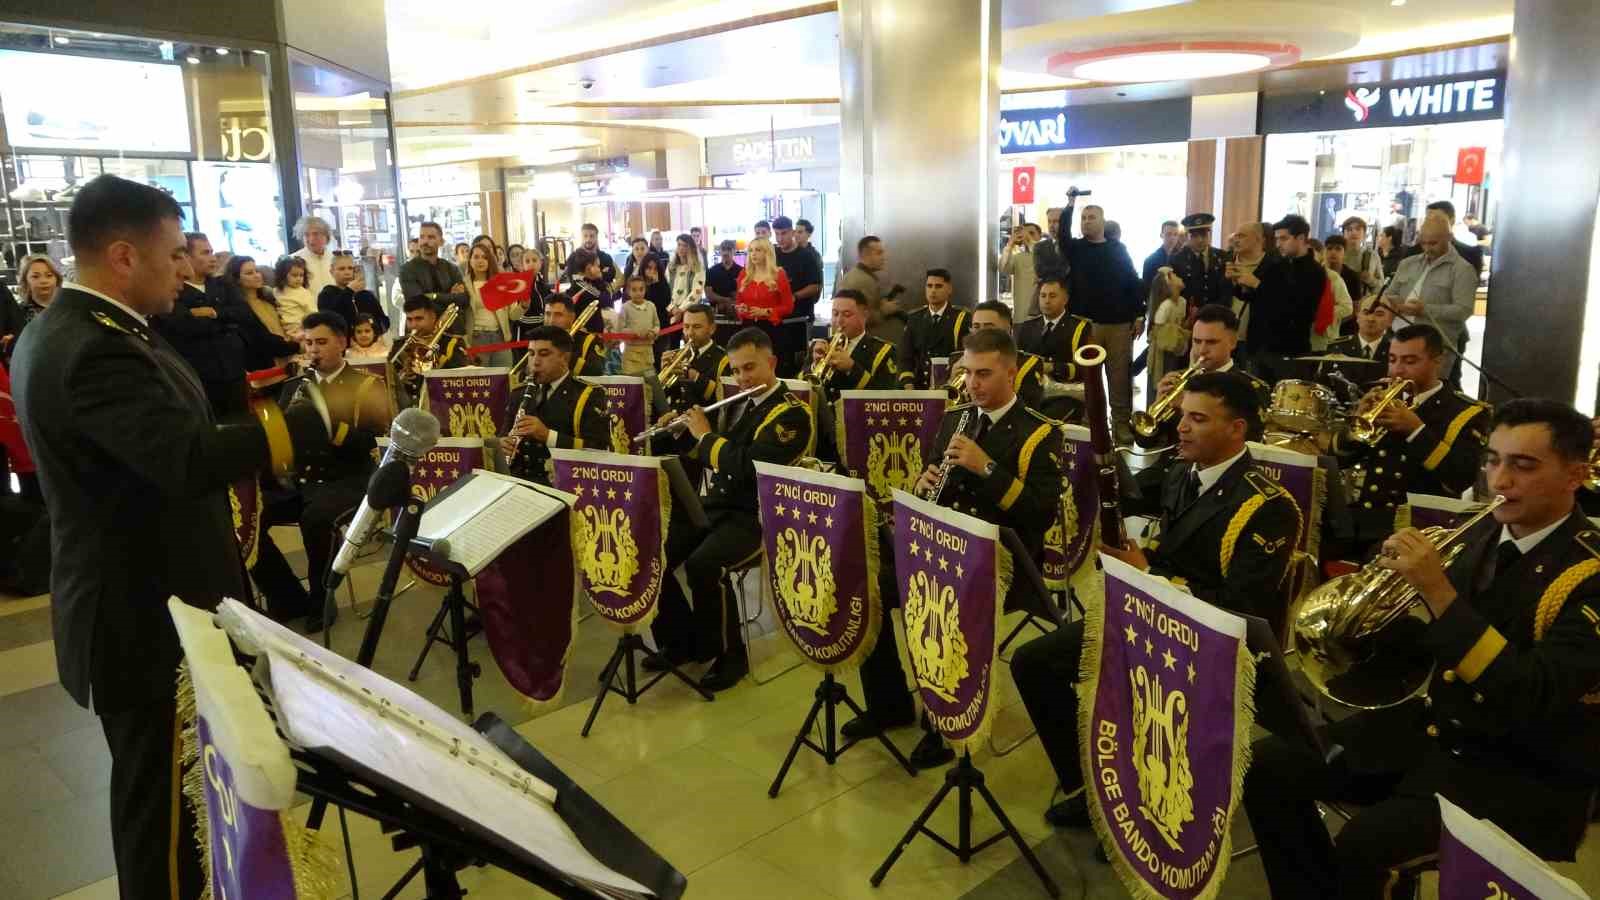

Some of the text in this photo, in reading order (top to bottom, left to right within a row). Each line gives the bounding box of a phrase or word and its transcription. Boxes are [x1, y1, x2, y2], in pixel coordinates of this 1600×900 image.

[1389, 78, 1496, 117] WHITE
[466, 376, 491, 387] ORDU
[893, 402, 924, 412] ORDU
[430, 452, 460, 463] ORDU
[601, 469, 634, 483] ORDU
[803, 490, 836, 508] ORDU
[910, 516, 934, 542] 2'NCİ
[936, 528, 968, 555] ORDU
[1124, 593, 1199, 652] 2'NCİ ORDU
[1097, 718, 1122, 801] BÖLGE
[1113, 804, 1160, 874] BANDO
